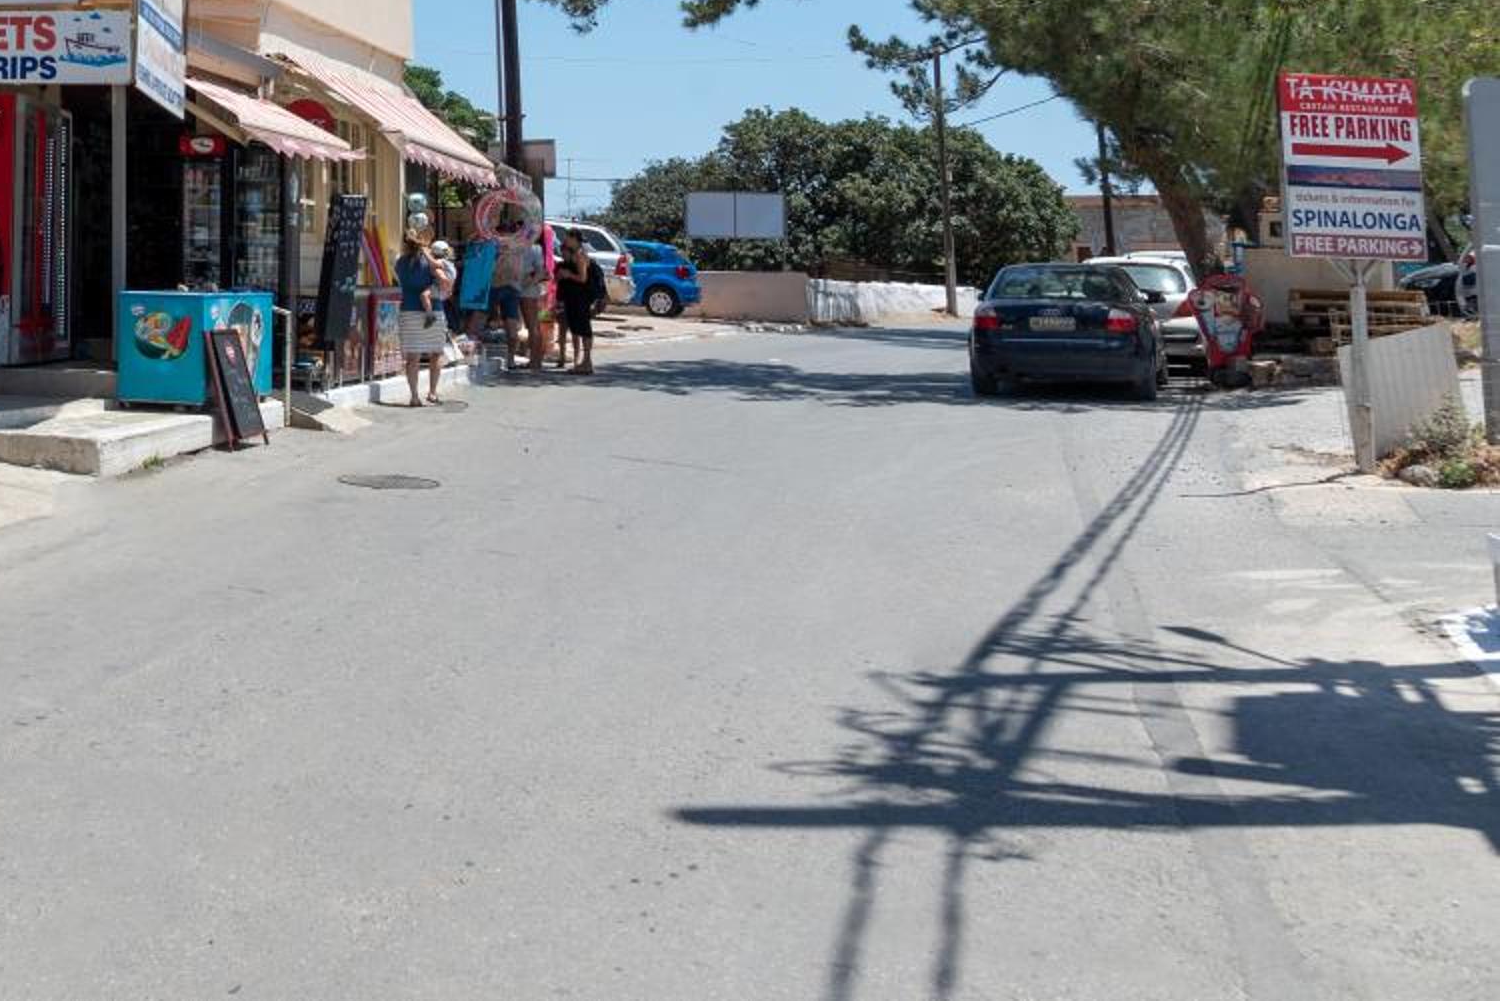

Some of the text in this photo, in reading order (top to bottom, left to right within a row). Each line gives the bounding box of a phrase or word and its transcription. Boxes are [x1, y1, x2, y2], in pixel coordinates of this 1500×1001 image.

[1290, 116, 1412, 142] FREE PARKING
[1292, 208, 1420, 232] SPINALONGA
[1296, 235, 1408, 256] FREE PARKING
